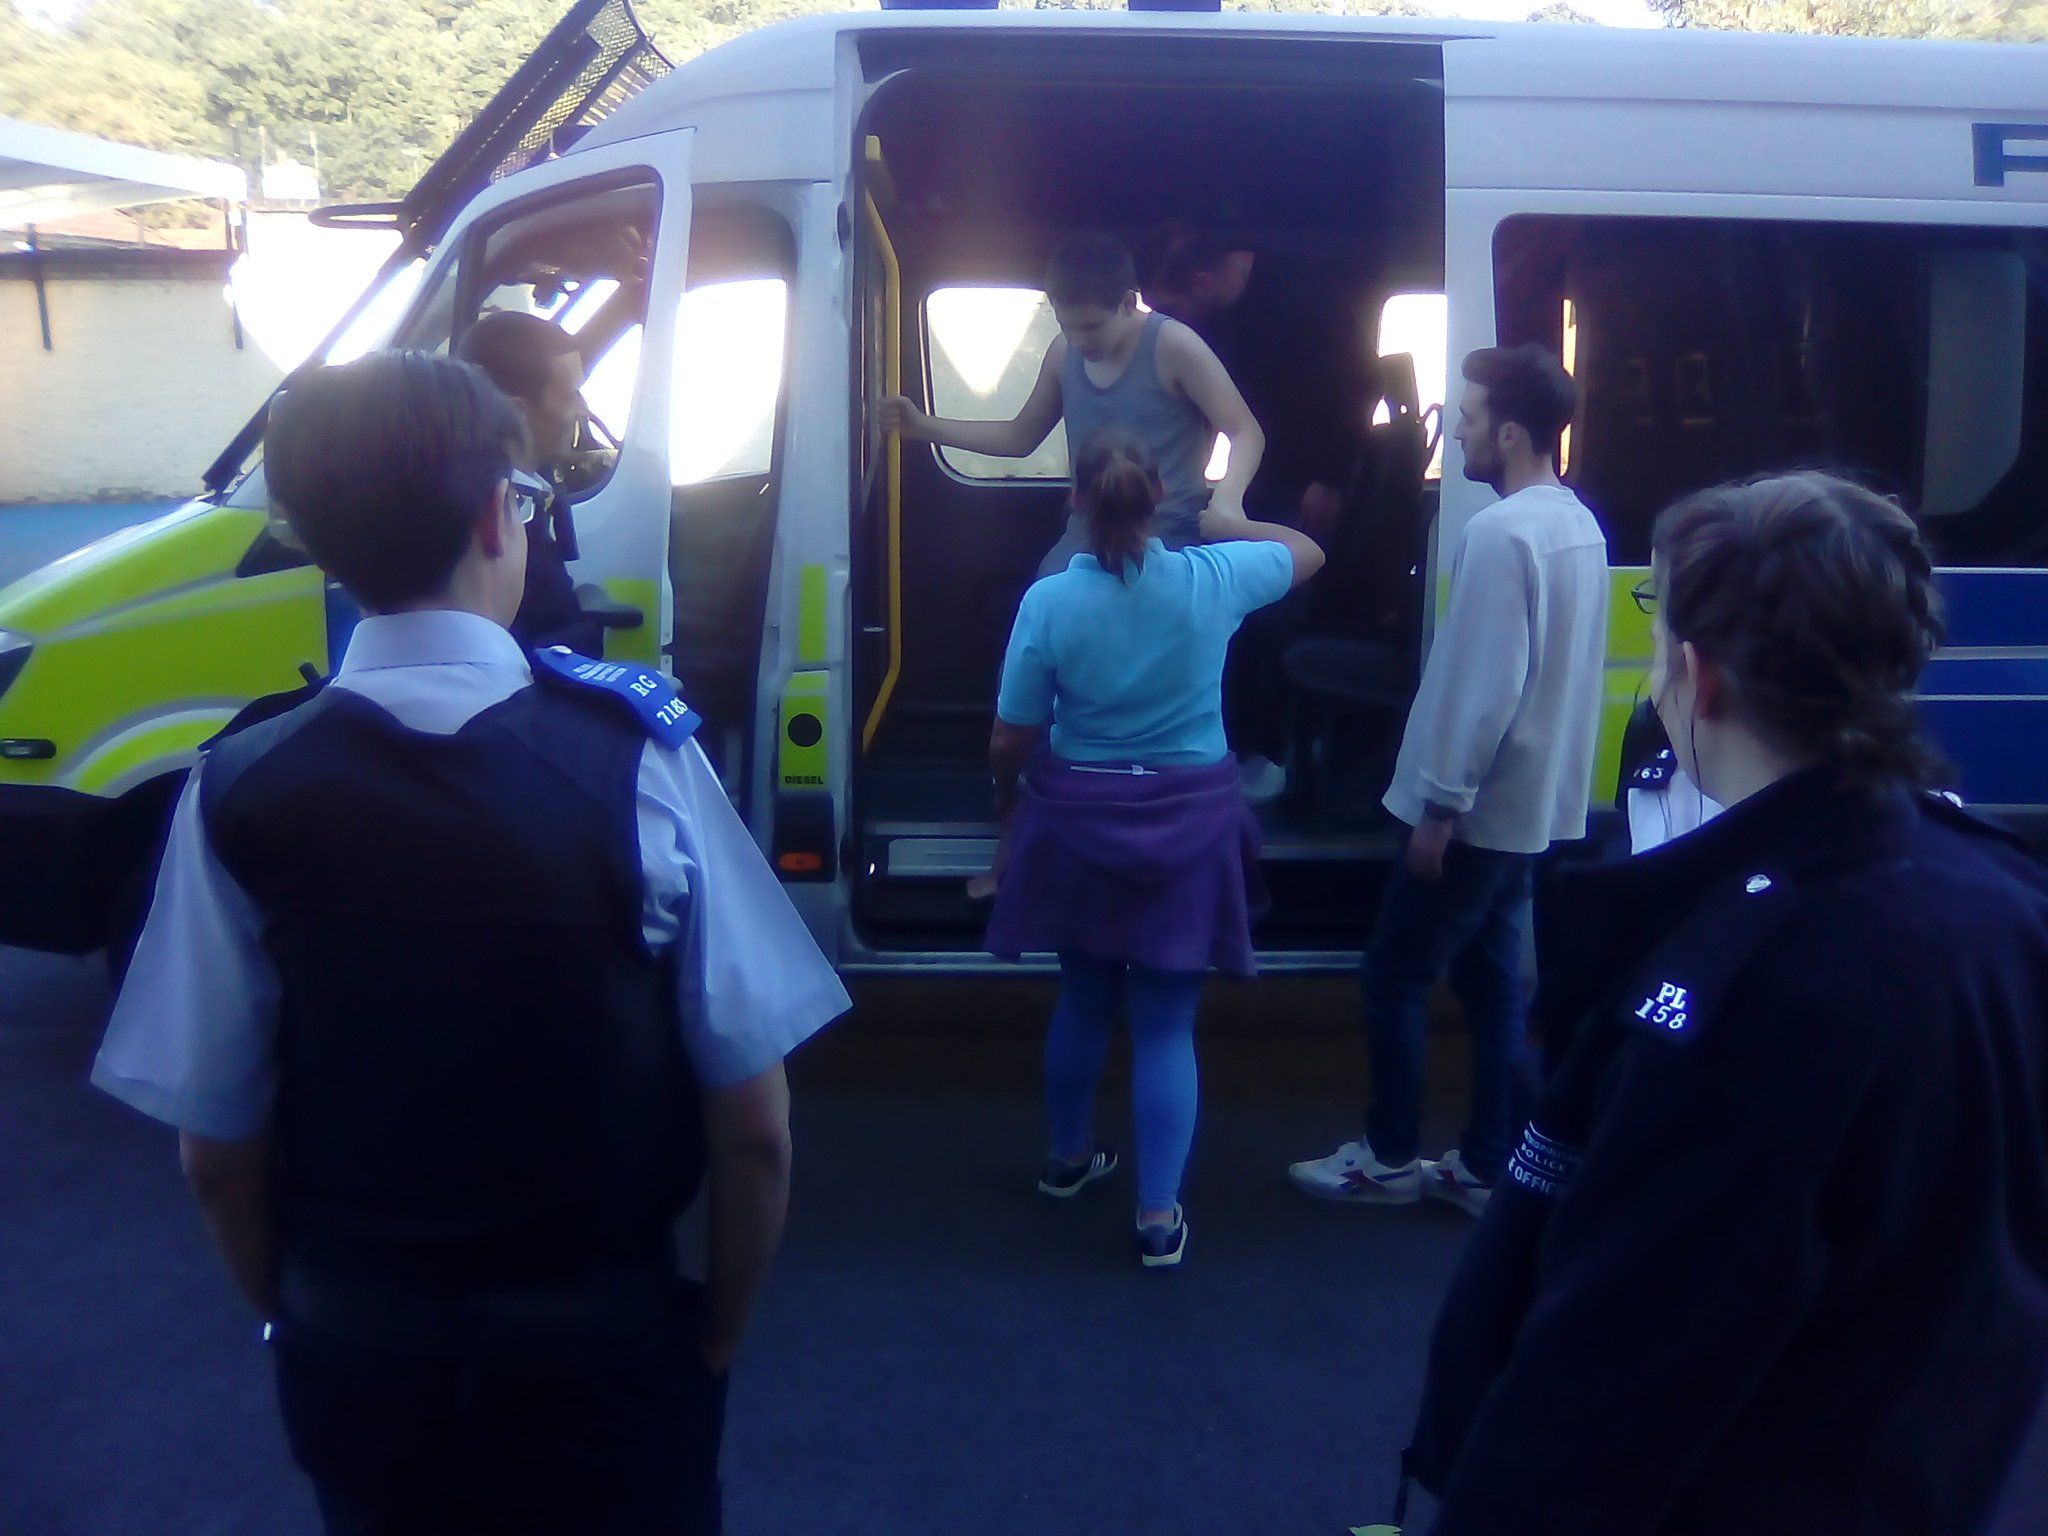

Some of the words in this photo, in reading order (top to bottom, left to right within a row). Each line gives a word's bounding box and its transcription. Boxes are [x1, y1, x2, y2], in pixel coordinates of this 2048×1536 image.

[630, 674, 658, 698] RG
[784, 775, 824, 785] DIESEL
[1656, 981, 1687, 1010] PL
[1634, 998, 1687, 1029] 158
[1521, 1142, 1567, 1173] POLICE
